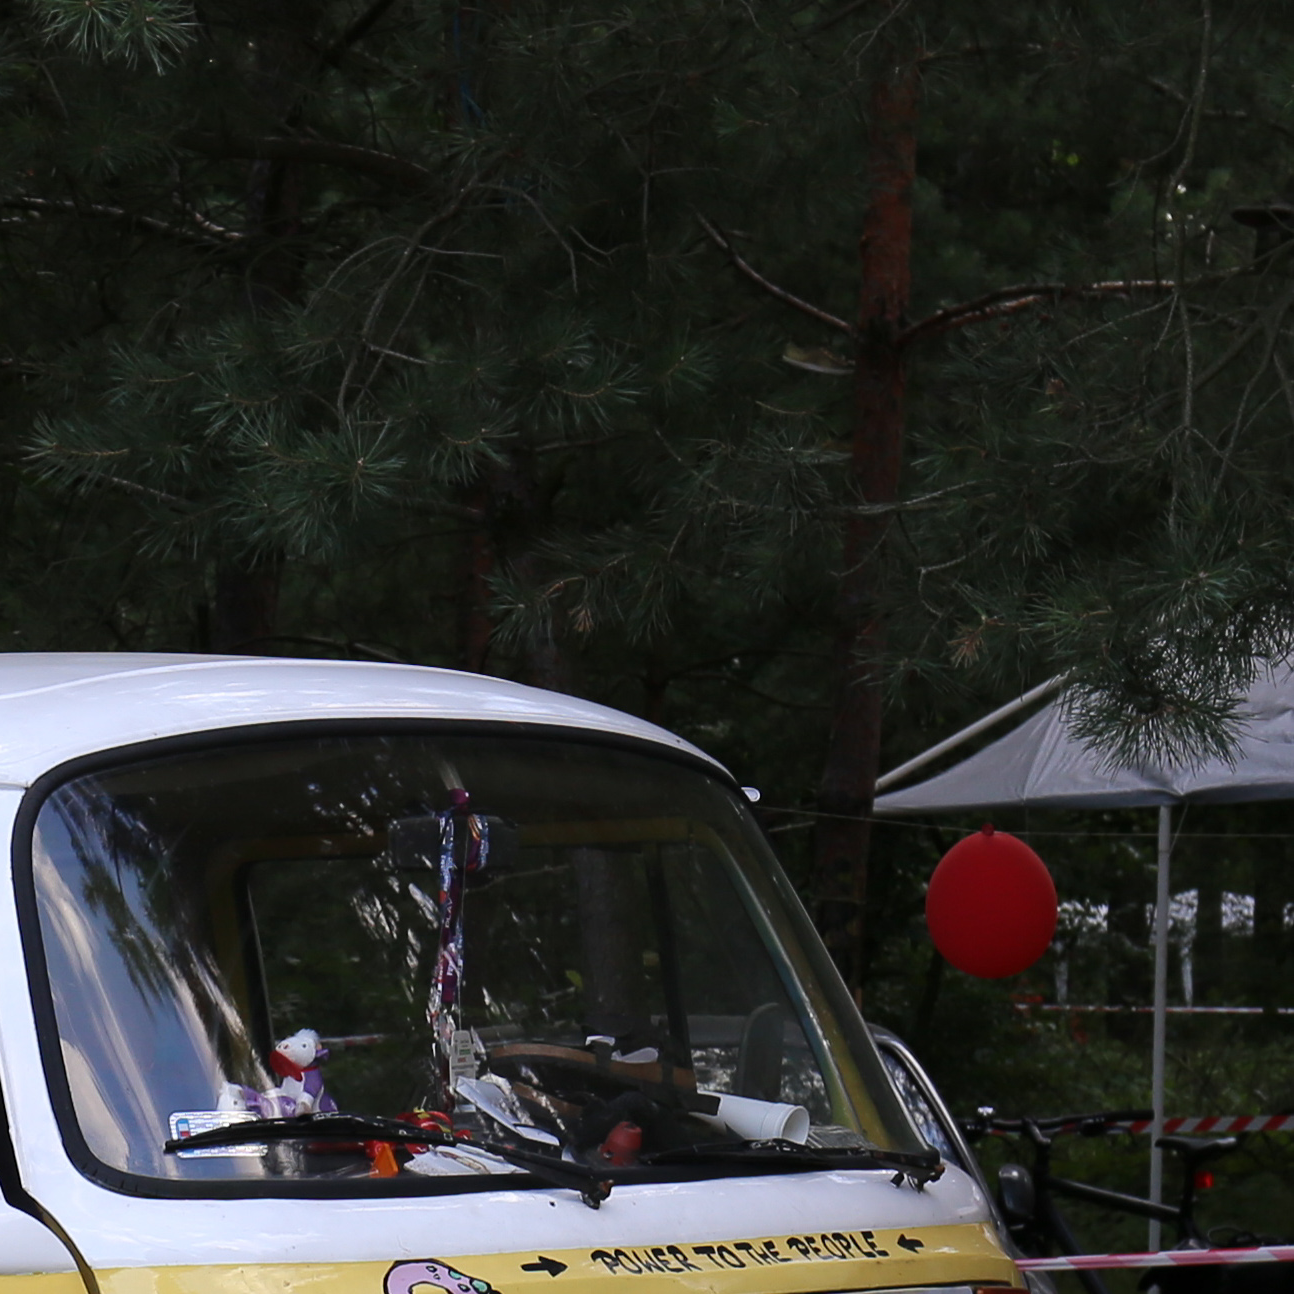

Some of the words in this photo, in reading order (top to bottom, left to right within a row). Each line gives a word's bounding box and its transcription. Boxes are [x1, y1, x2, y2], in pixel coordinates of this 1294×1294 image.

[591, 1245, 702, 1275] POWER
[692, 1245, 746, 1269] TO
[735, 1239, 792, 1266] THE
[787, 1230, 890, 1261] PEOPLE
